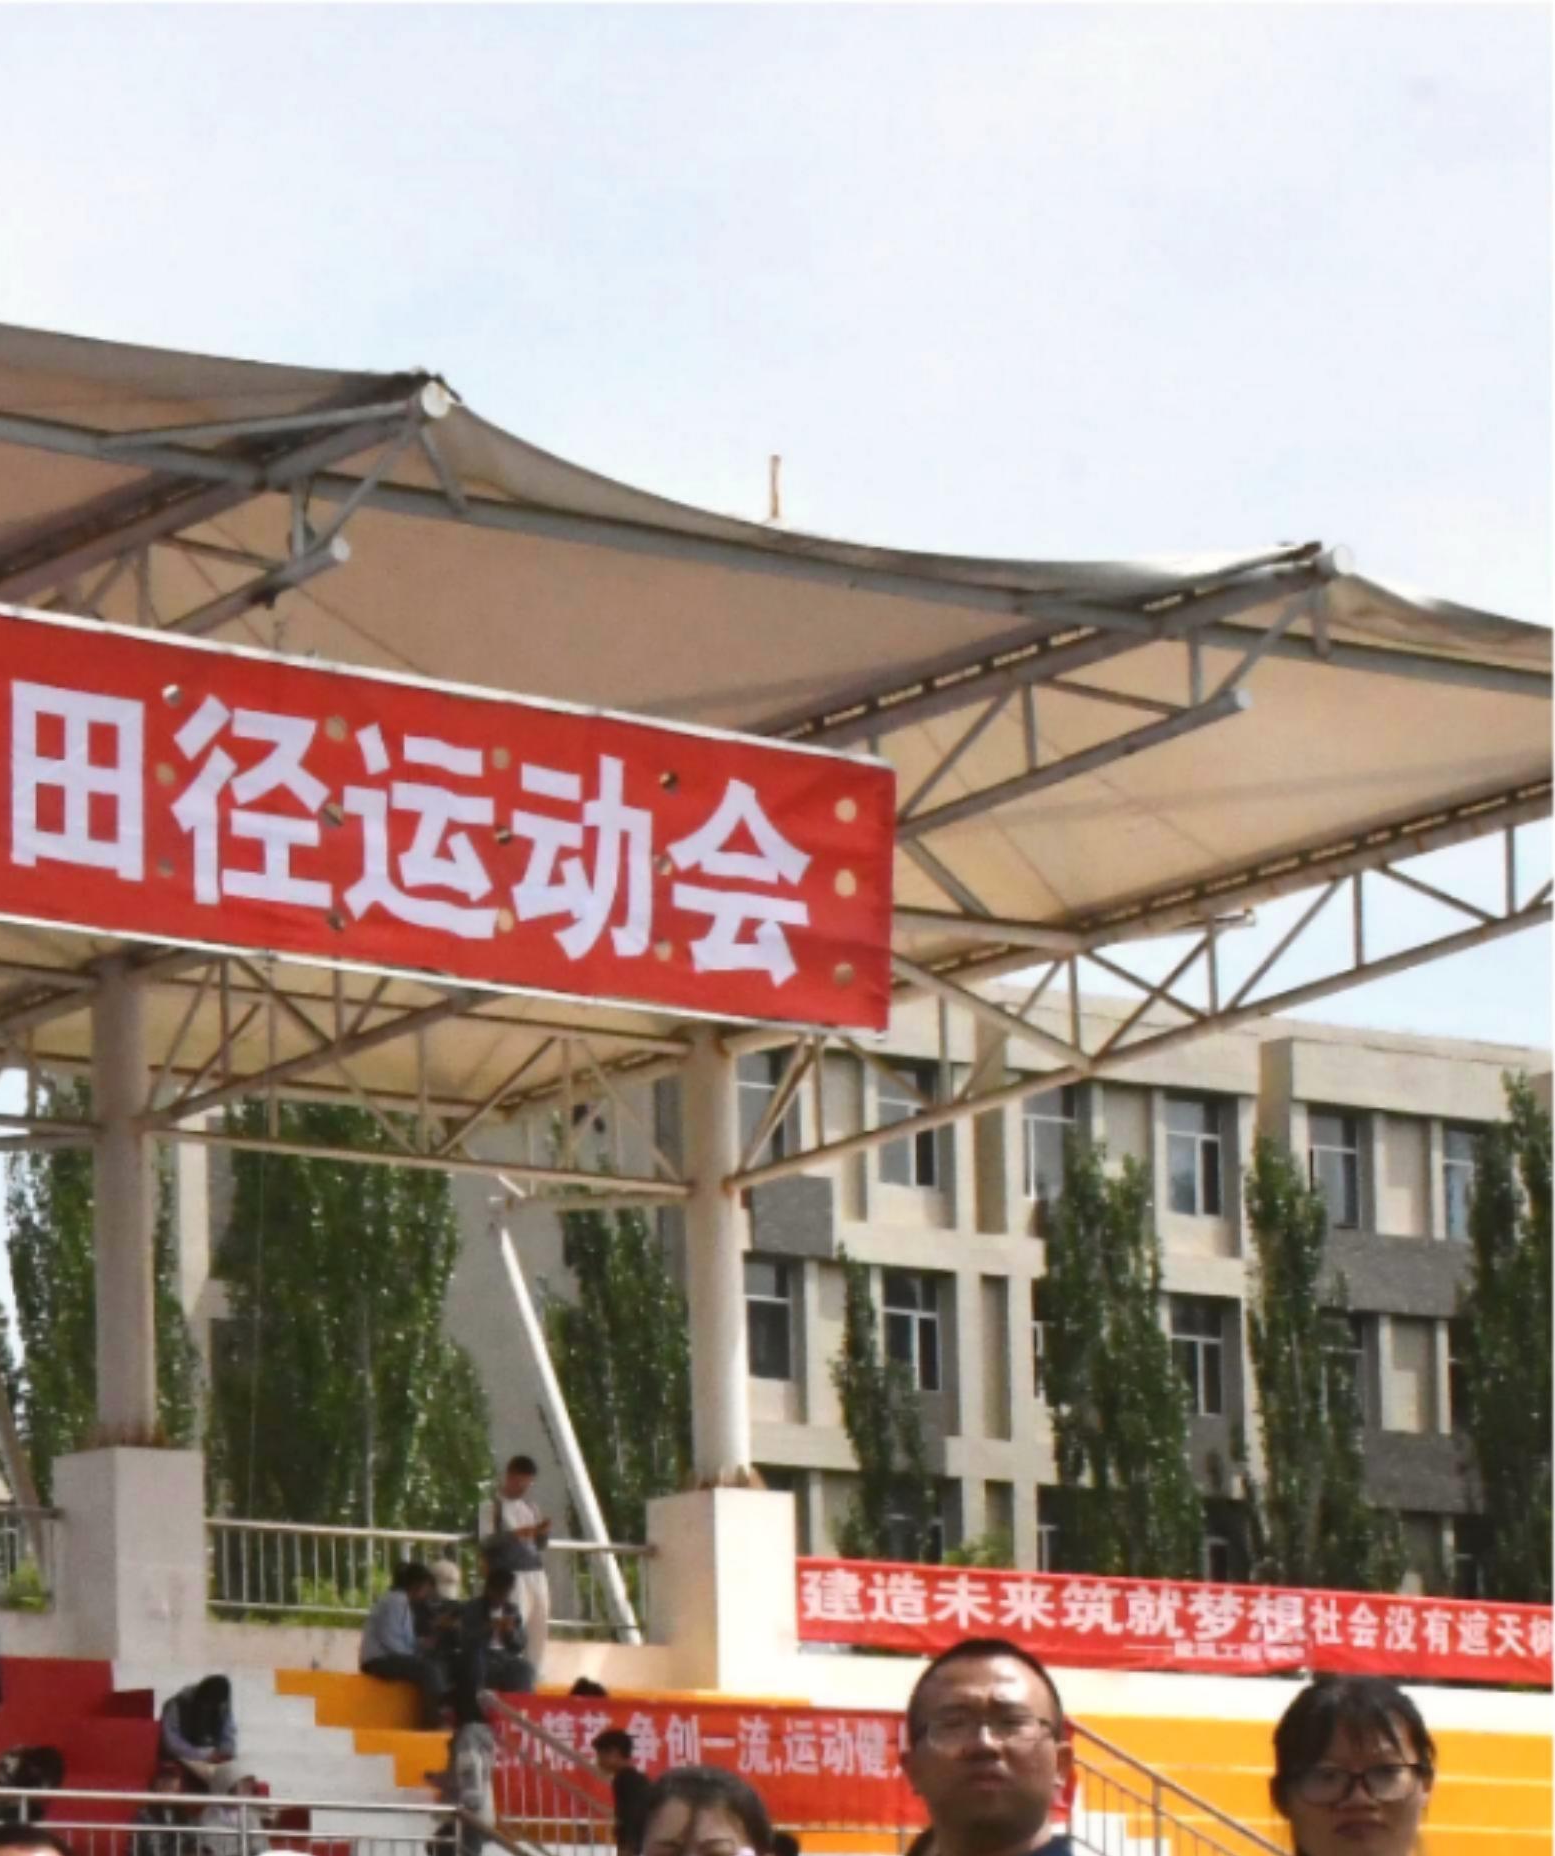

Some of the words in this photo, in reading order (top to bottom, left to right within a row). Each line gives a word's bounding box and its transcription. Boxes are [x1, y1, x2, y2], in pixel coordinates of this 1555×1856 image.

[10, 680, 811, 987] 田径运动会
[801, 1567, 1305, 1642] 建造未来筑就梦想
